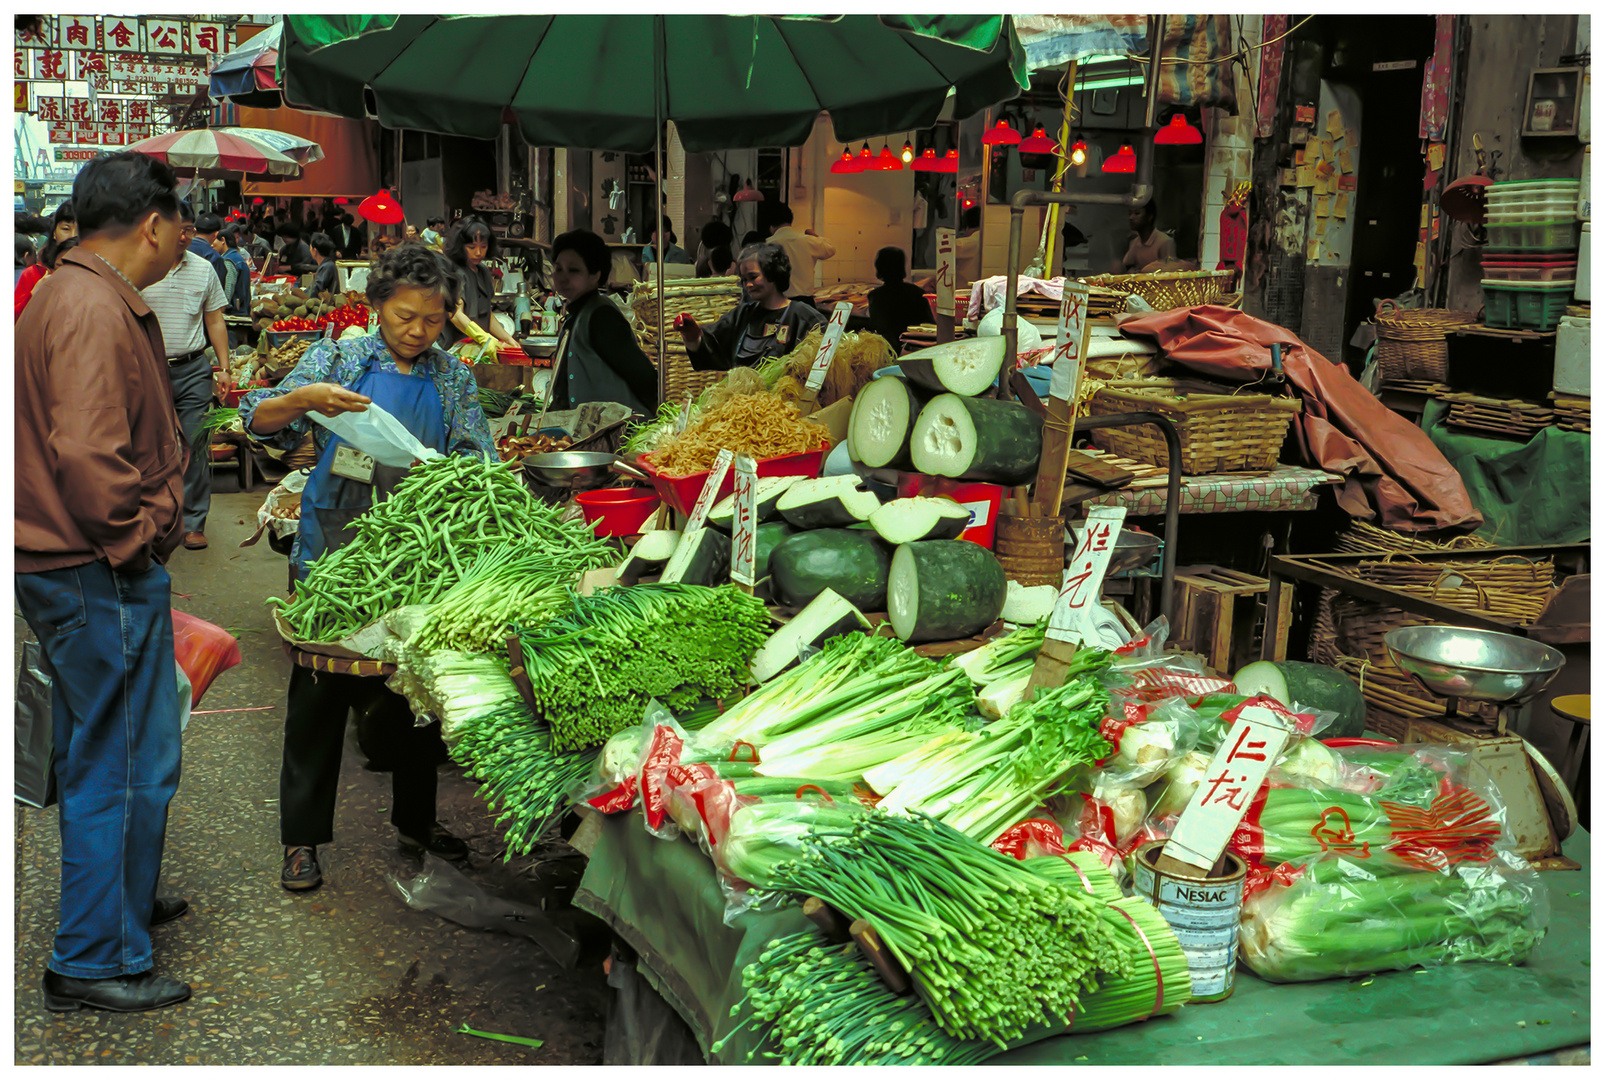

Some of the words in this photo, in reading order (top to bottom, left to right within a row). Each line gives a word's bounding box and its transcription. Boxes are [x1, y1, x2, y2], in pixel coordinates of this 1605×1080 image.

[39, 99, 150, 123] 流記海鮮
[936, 234, 953, 287] 三元
[814, 310, 843, 368] 八元
[1176, 887, 1227, 902] NESLAC
